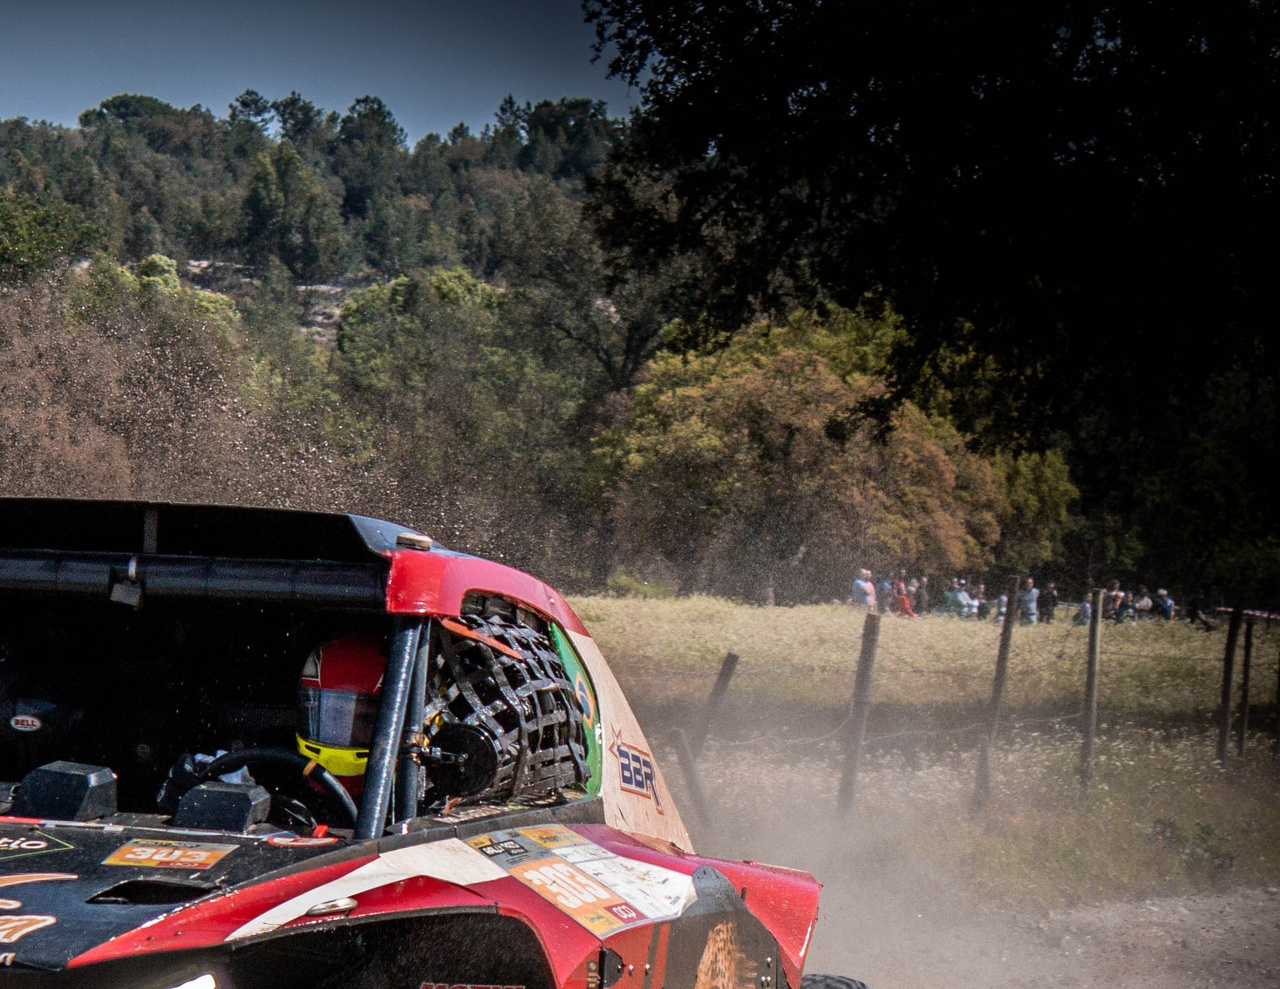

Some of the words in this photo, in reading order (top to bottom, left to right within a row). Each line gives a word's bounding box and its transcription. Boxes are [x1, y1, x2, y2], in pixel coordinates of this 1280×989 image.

[13, 718, 37, 727] BELL
[618, 746, 662, 812] BBR
[124, 847, 211, 863] 303
[523, 863, 612, 909] 303
